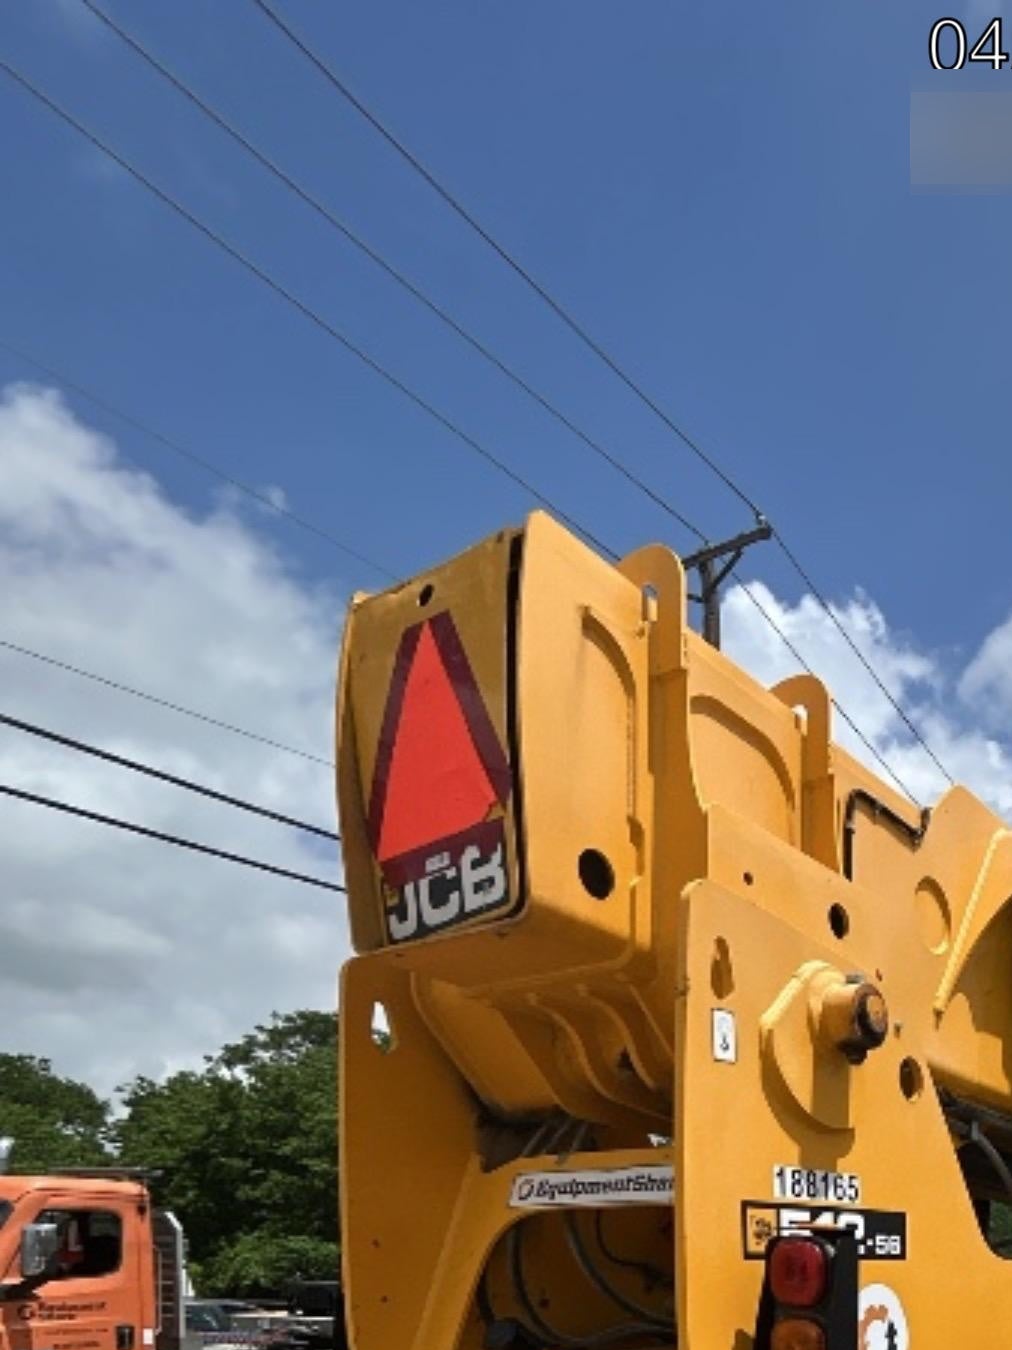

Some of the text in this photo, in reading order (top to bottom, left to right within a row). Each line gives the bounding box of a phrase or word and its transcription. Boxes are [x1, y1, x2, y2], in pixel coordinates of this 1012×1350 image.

[389, 841, 507, 940] JCB
[534, 1173, 676, 1200] EquipmentShar
[776, 1166, 859, 1203] 188165
